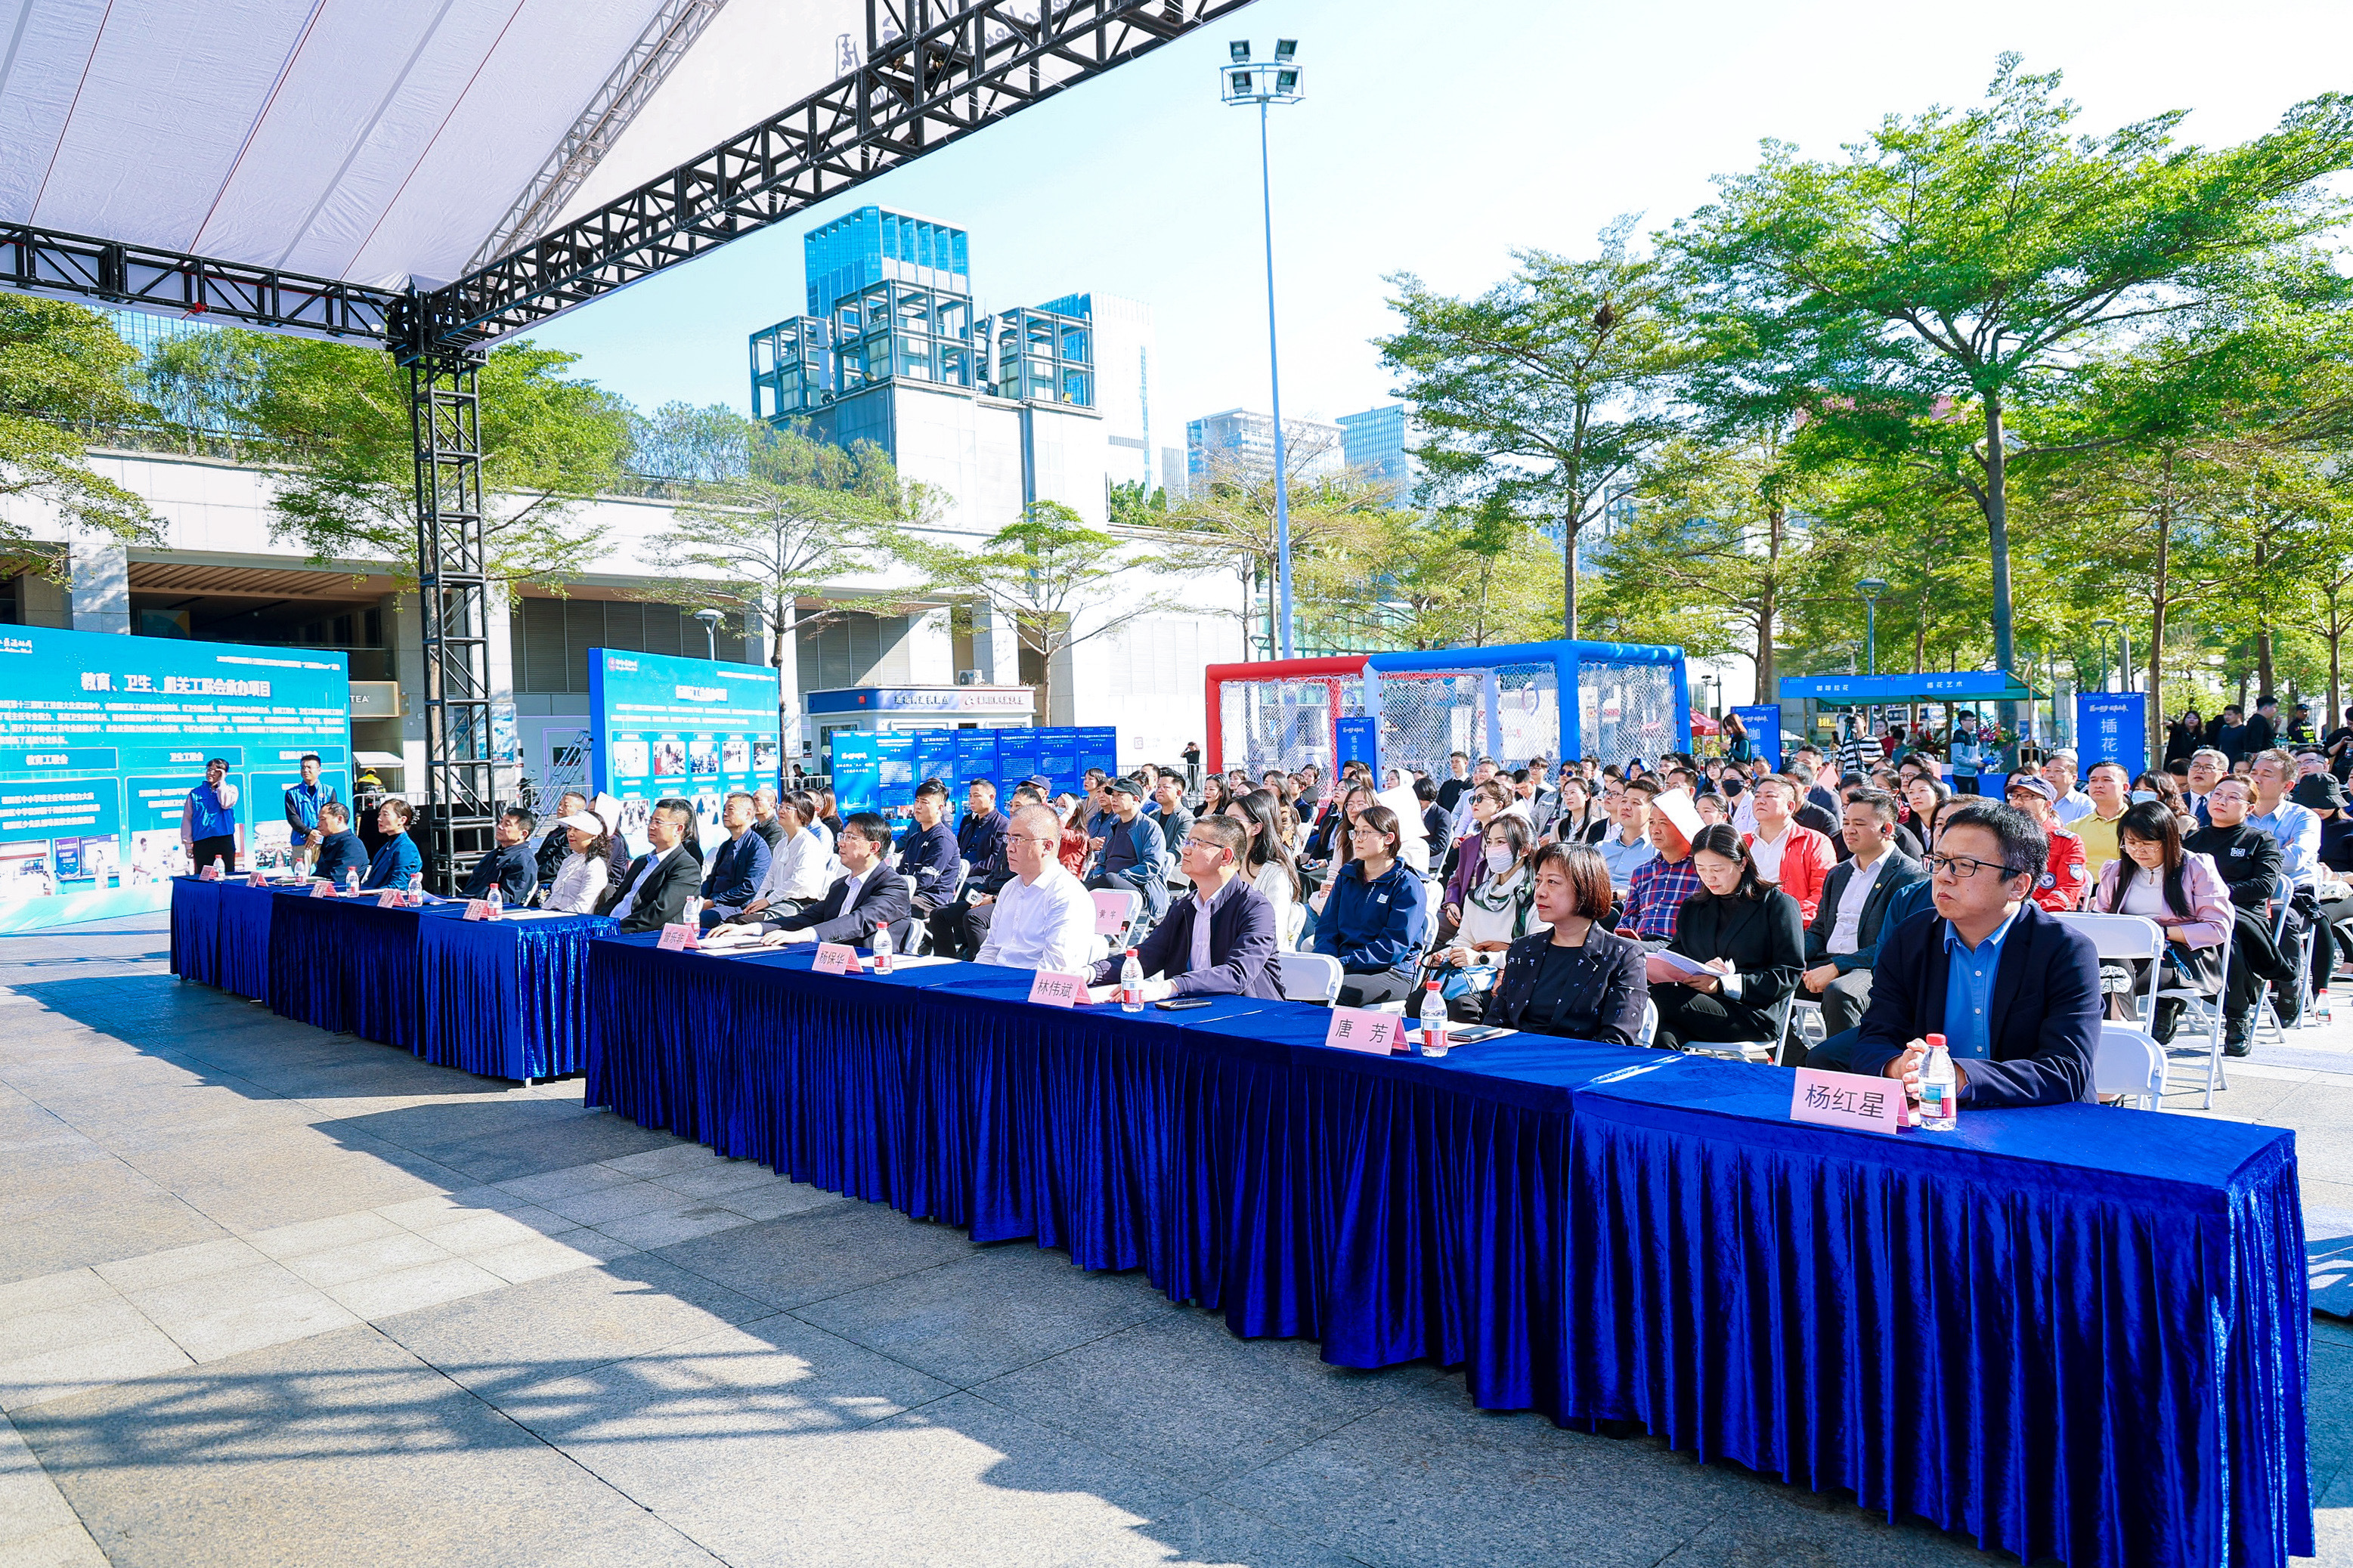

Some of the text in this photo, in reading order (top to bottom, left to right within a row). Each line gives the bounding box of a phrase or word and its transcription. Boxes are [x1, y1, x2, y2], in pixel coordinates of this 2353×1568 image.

[81, 672, 271, 697] 教育、卫生、机关工联会承办项目
[1927, 681, 1963, 689] 插花艺术
[818, 950, 845, 966] 杨保华
[1036, 979, 1073, 999] 林伟斌
[1804, 1083, 1884, 1119] 杨红星
